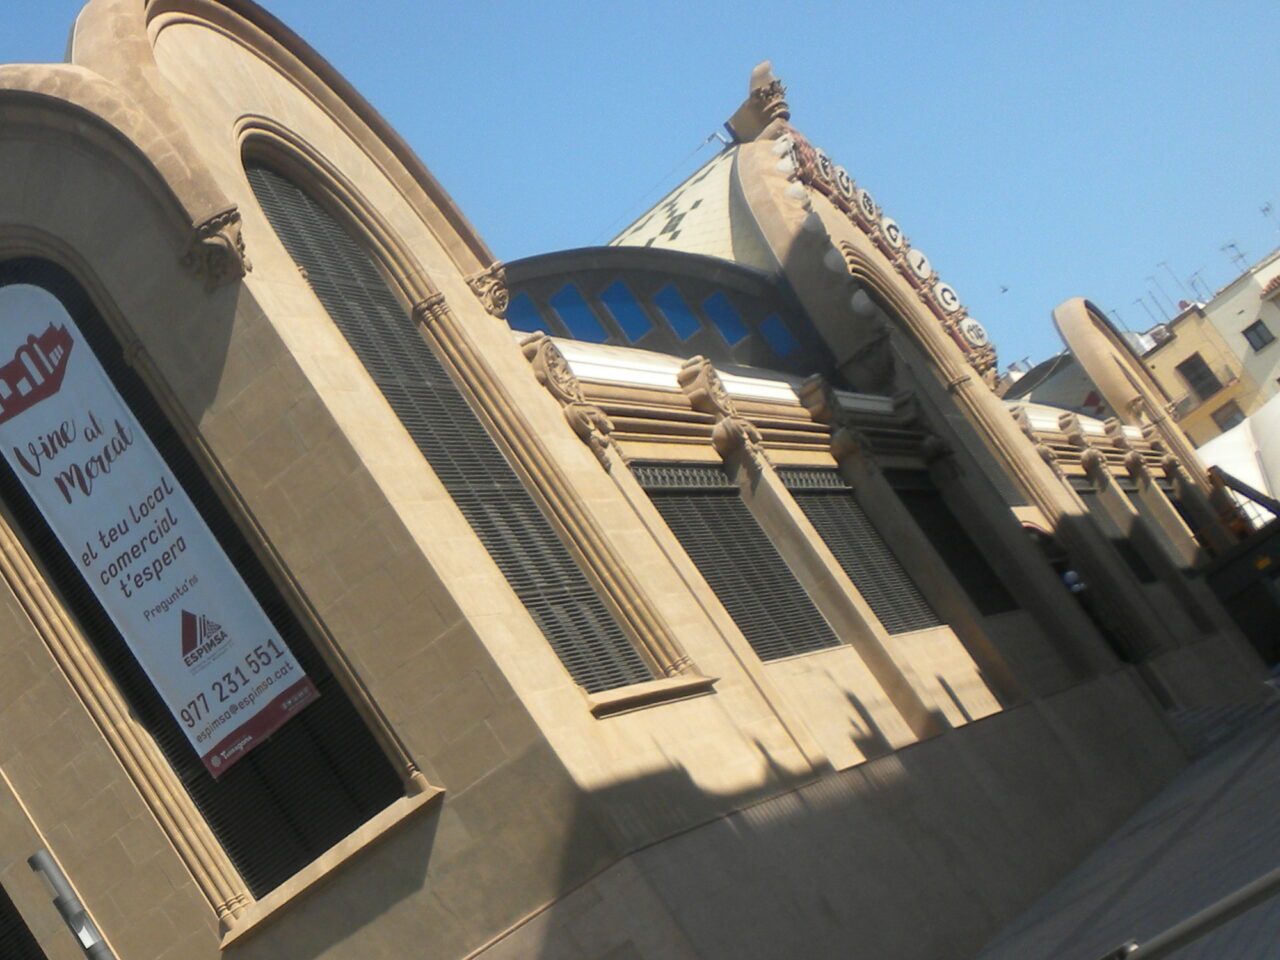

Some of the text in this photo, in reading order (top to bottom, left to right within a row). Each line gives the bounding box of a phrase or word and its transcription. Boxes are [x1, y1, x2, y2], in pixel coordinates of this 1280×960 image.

[13, 409, 104, 477] Vine al
[54, 418, 133, 505] Mercat
[81, 476, 174, 567] el teu local
[99, 507, 178, 585] comercial
[119, 535, 187, 598] t'espera
[143, 574, 199, 622] Pregunta'ns
[180, 692, 210, 728] 977
[211, 665, 251, 702] 231
[244, 638, 285, 675] 551
[183, 629, 229, 668] ESPIMSA
[196, 661, 294, 743] espimsa@espimsa.cat
